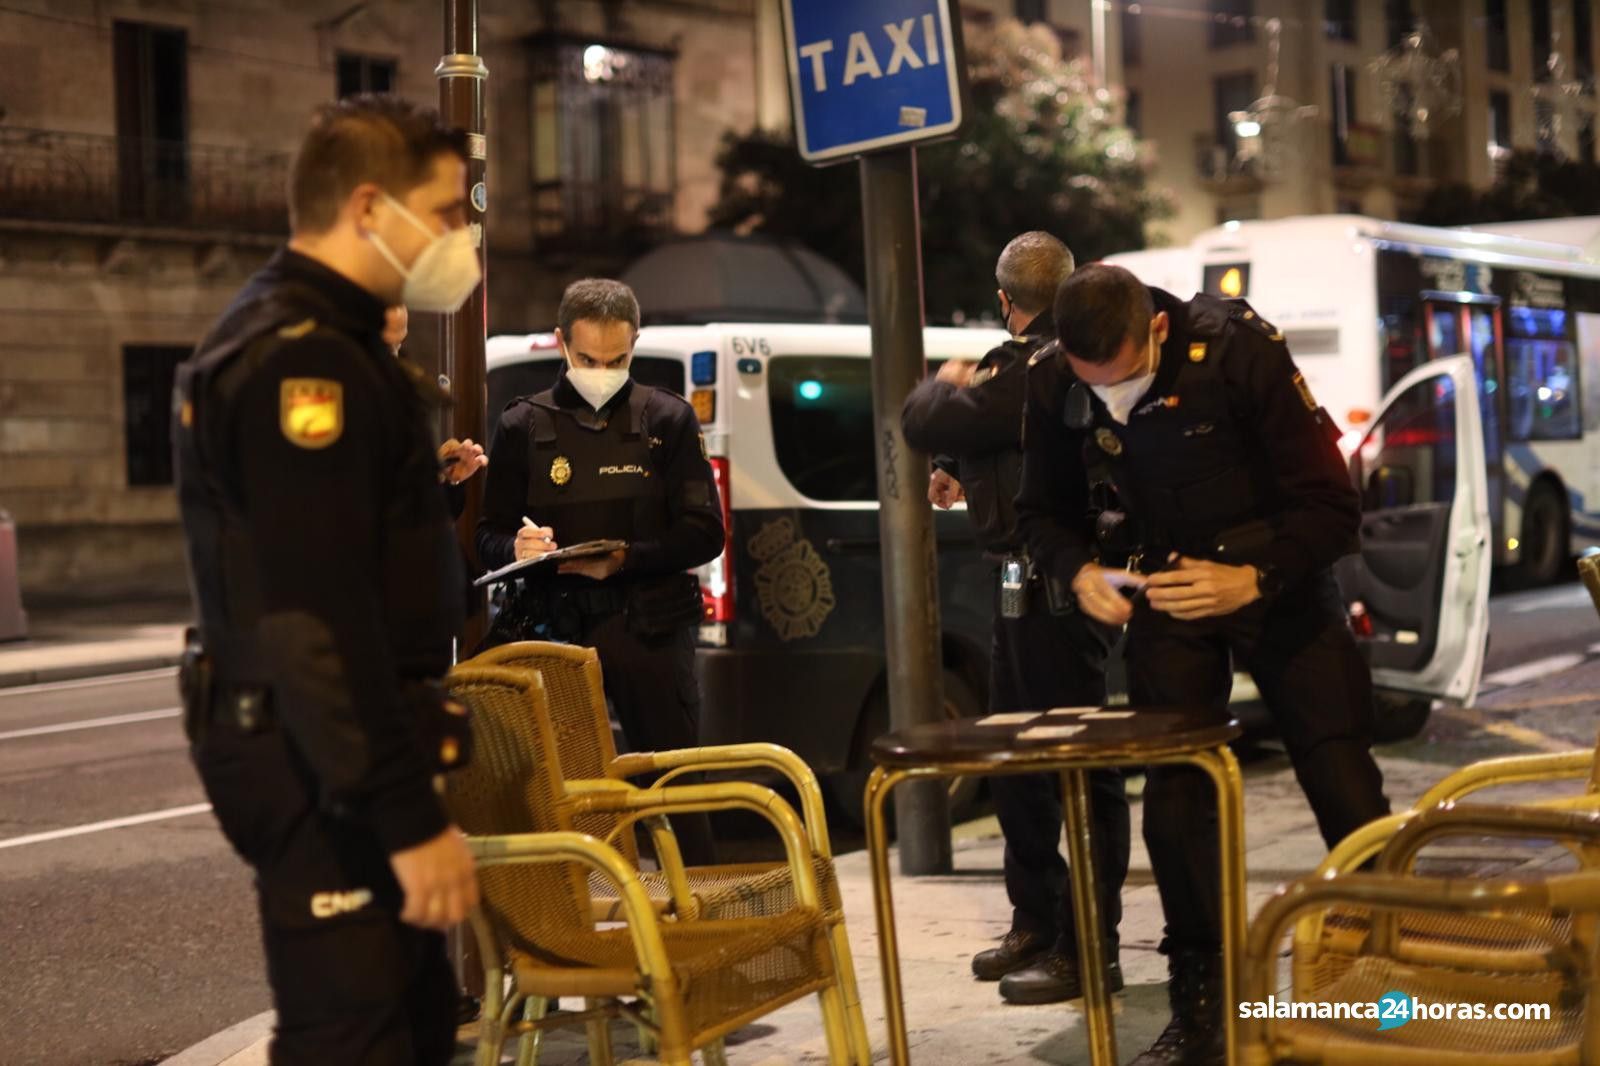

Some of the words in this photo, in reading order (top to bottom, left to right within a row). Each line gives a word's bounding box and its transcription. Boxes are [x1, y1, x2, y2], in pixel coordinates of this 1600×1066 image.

[800, 13, 940, 92] TAXI
[1220, 267, 1241, 297] 4
[732, 336, 771, 356] 6V6
[599, 464, 643, 474] POLICIA
